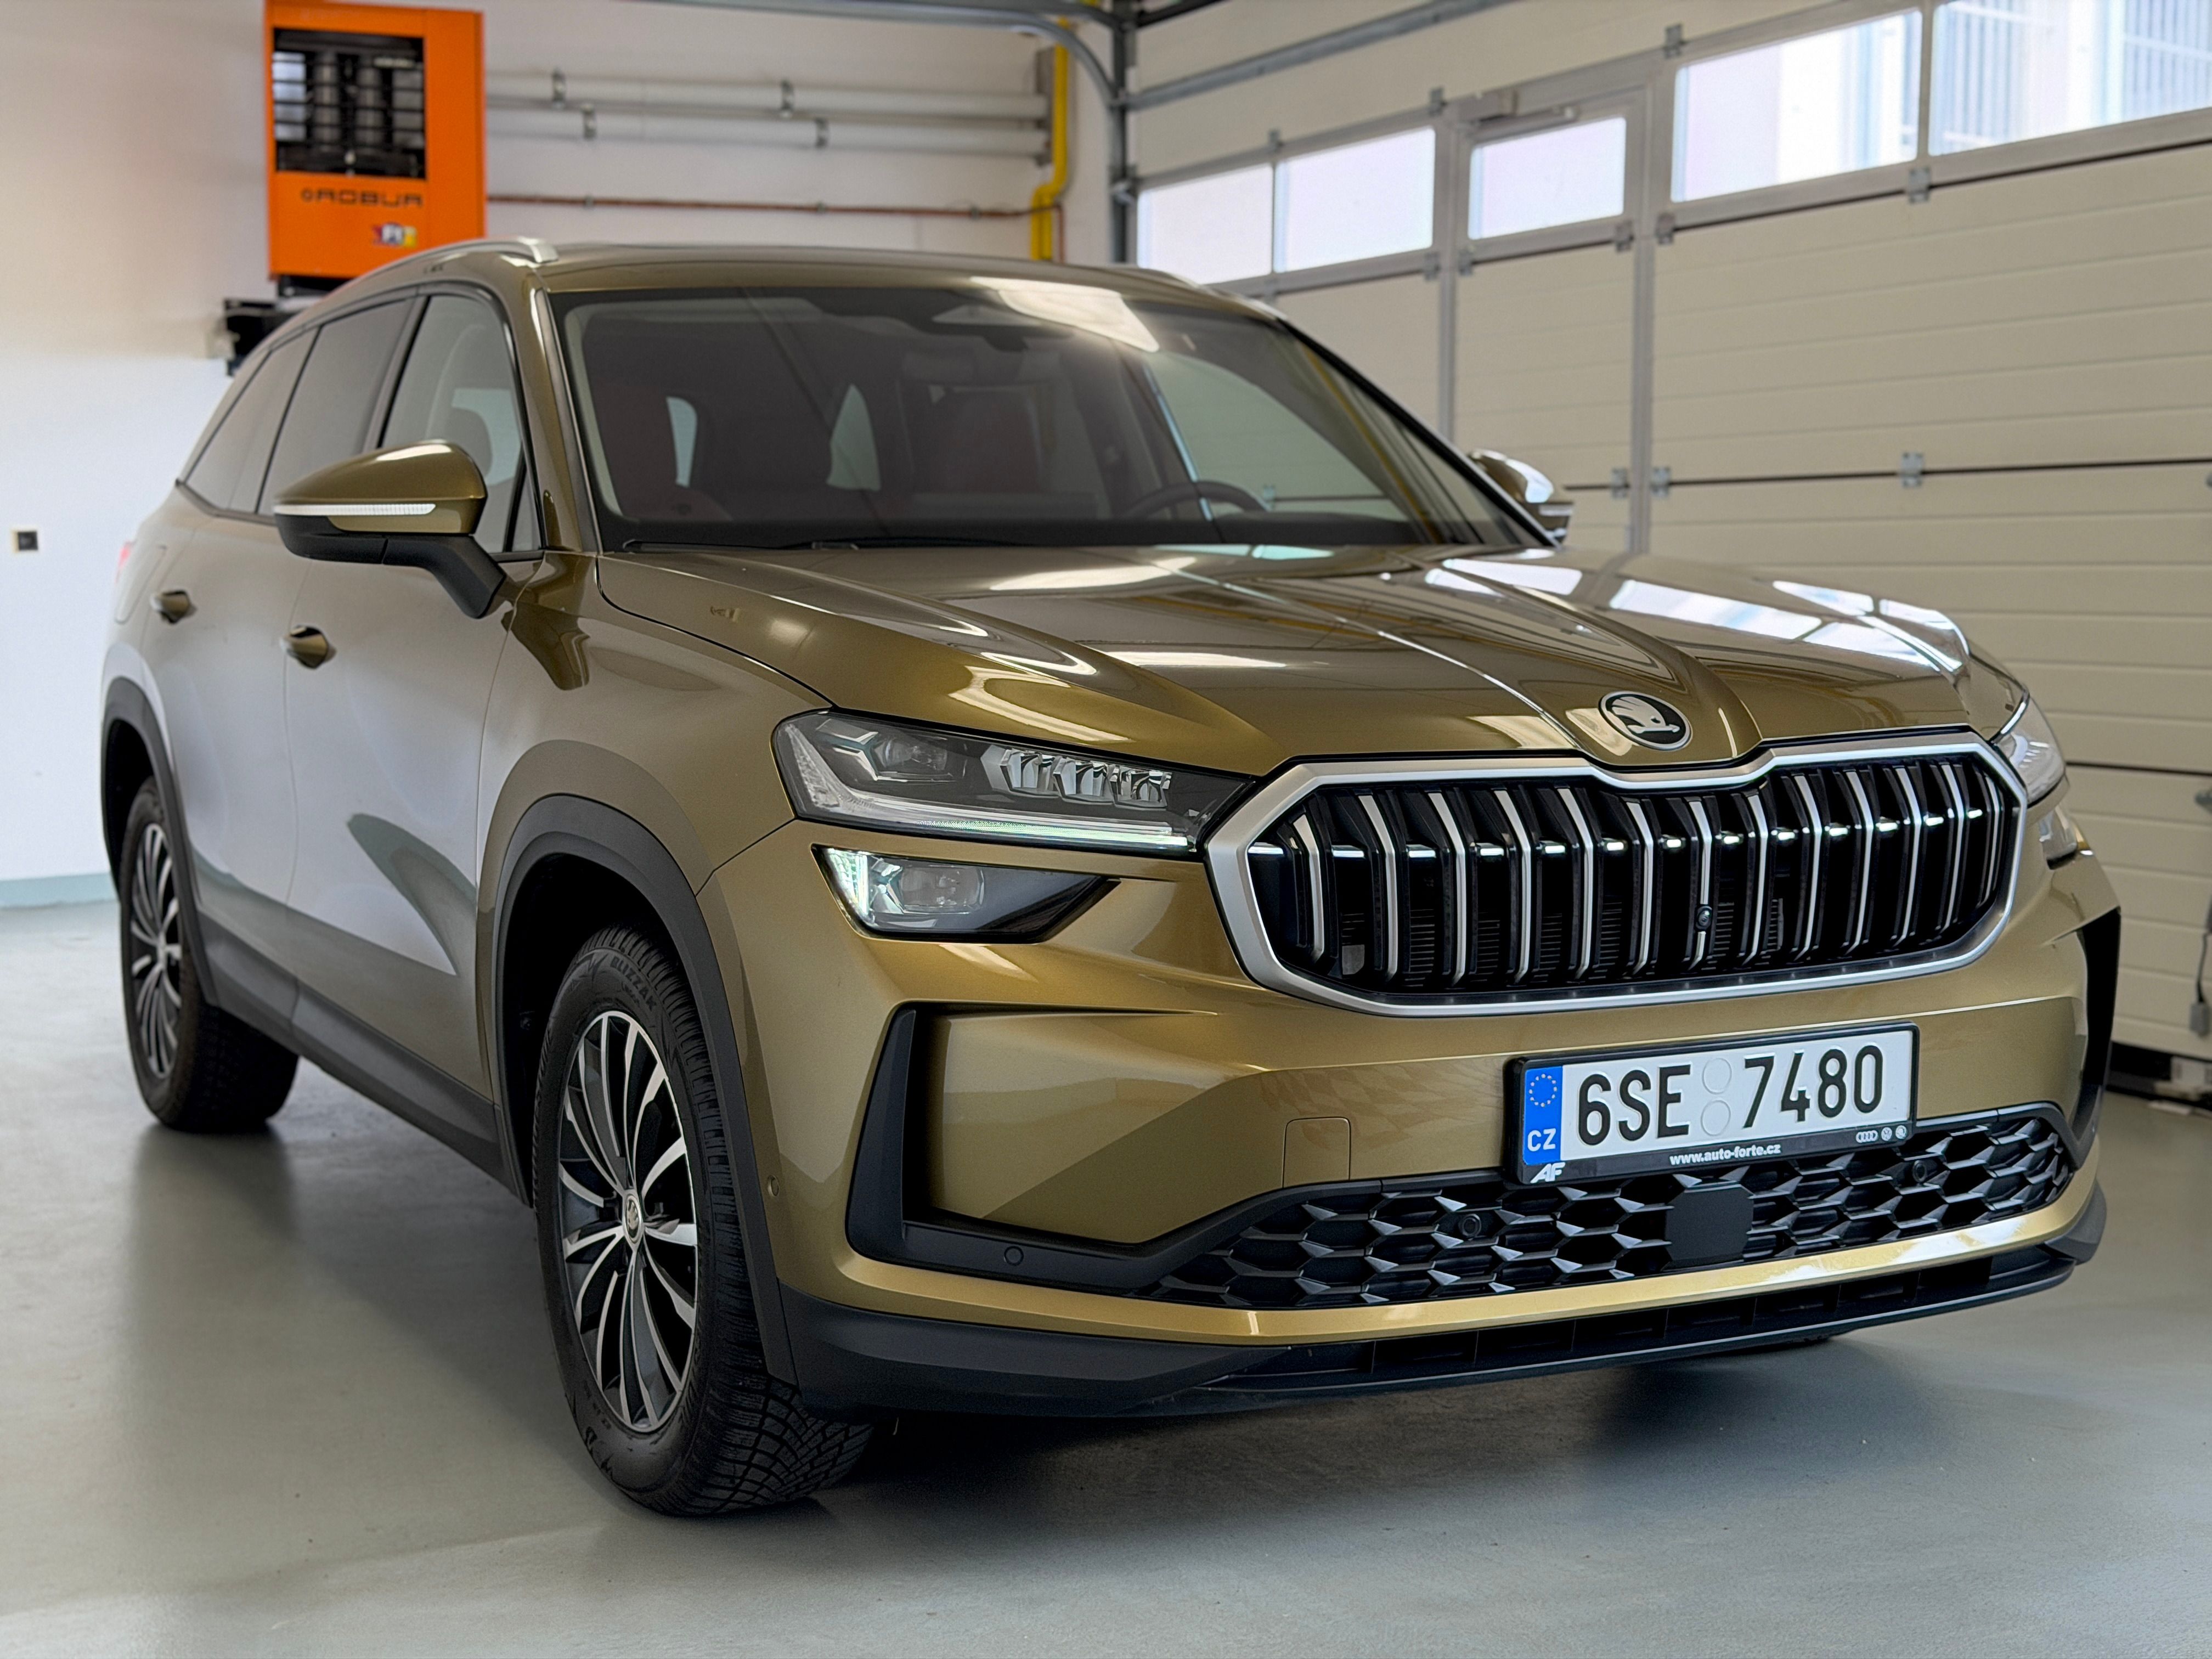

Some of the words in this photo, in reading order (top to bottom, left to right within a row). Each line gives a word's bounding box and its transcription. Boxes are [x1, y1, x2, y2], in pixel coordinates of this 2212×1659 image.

[1578, 1064, 1691, 1146] 6SE
[1743, 1044, 1883, 1130] 7480
[1527, 1128, 1557, 1152] CZ
[1669, 1143, 1781, 1166] www.auto-forte.cz
[1530, 1161, 1566, 1184] AF
